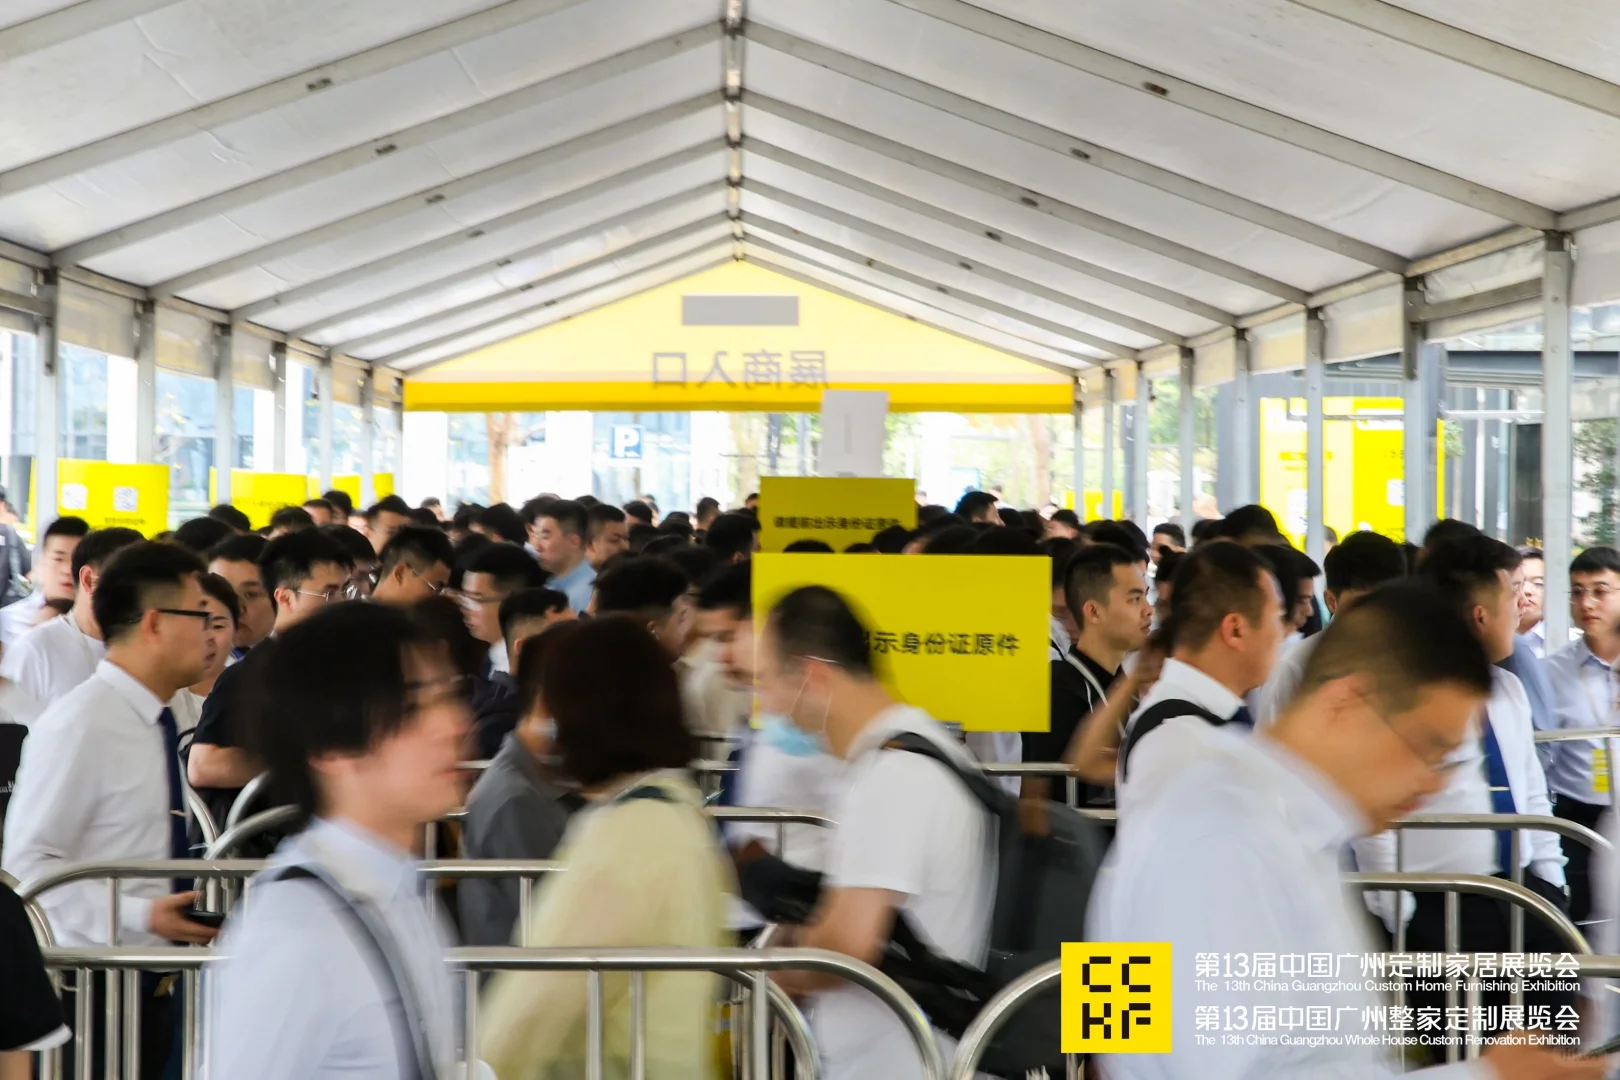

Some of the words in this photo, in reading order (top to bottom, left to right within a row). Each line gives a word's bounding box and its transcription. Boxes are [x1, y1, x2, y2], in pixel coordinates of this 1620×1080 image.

[613, 426, 640, 458] P
[864, 631, 1021, 656] 示身份证原件
